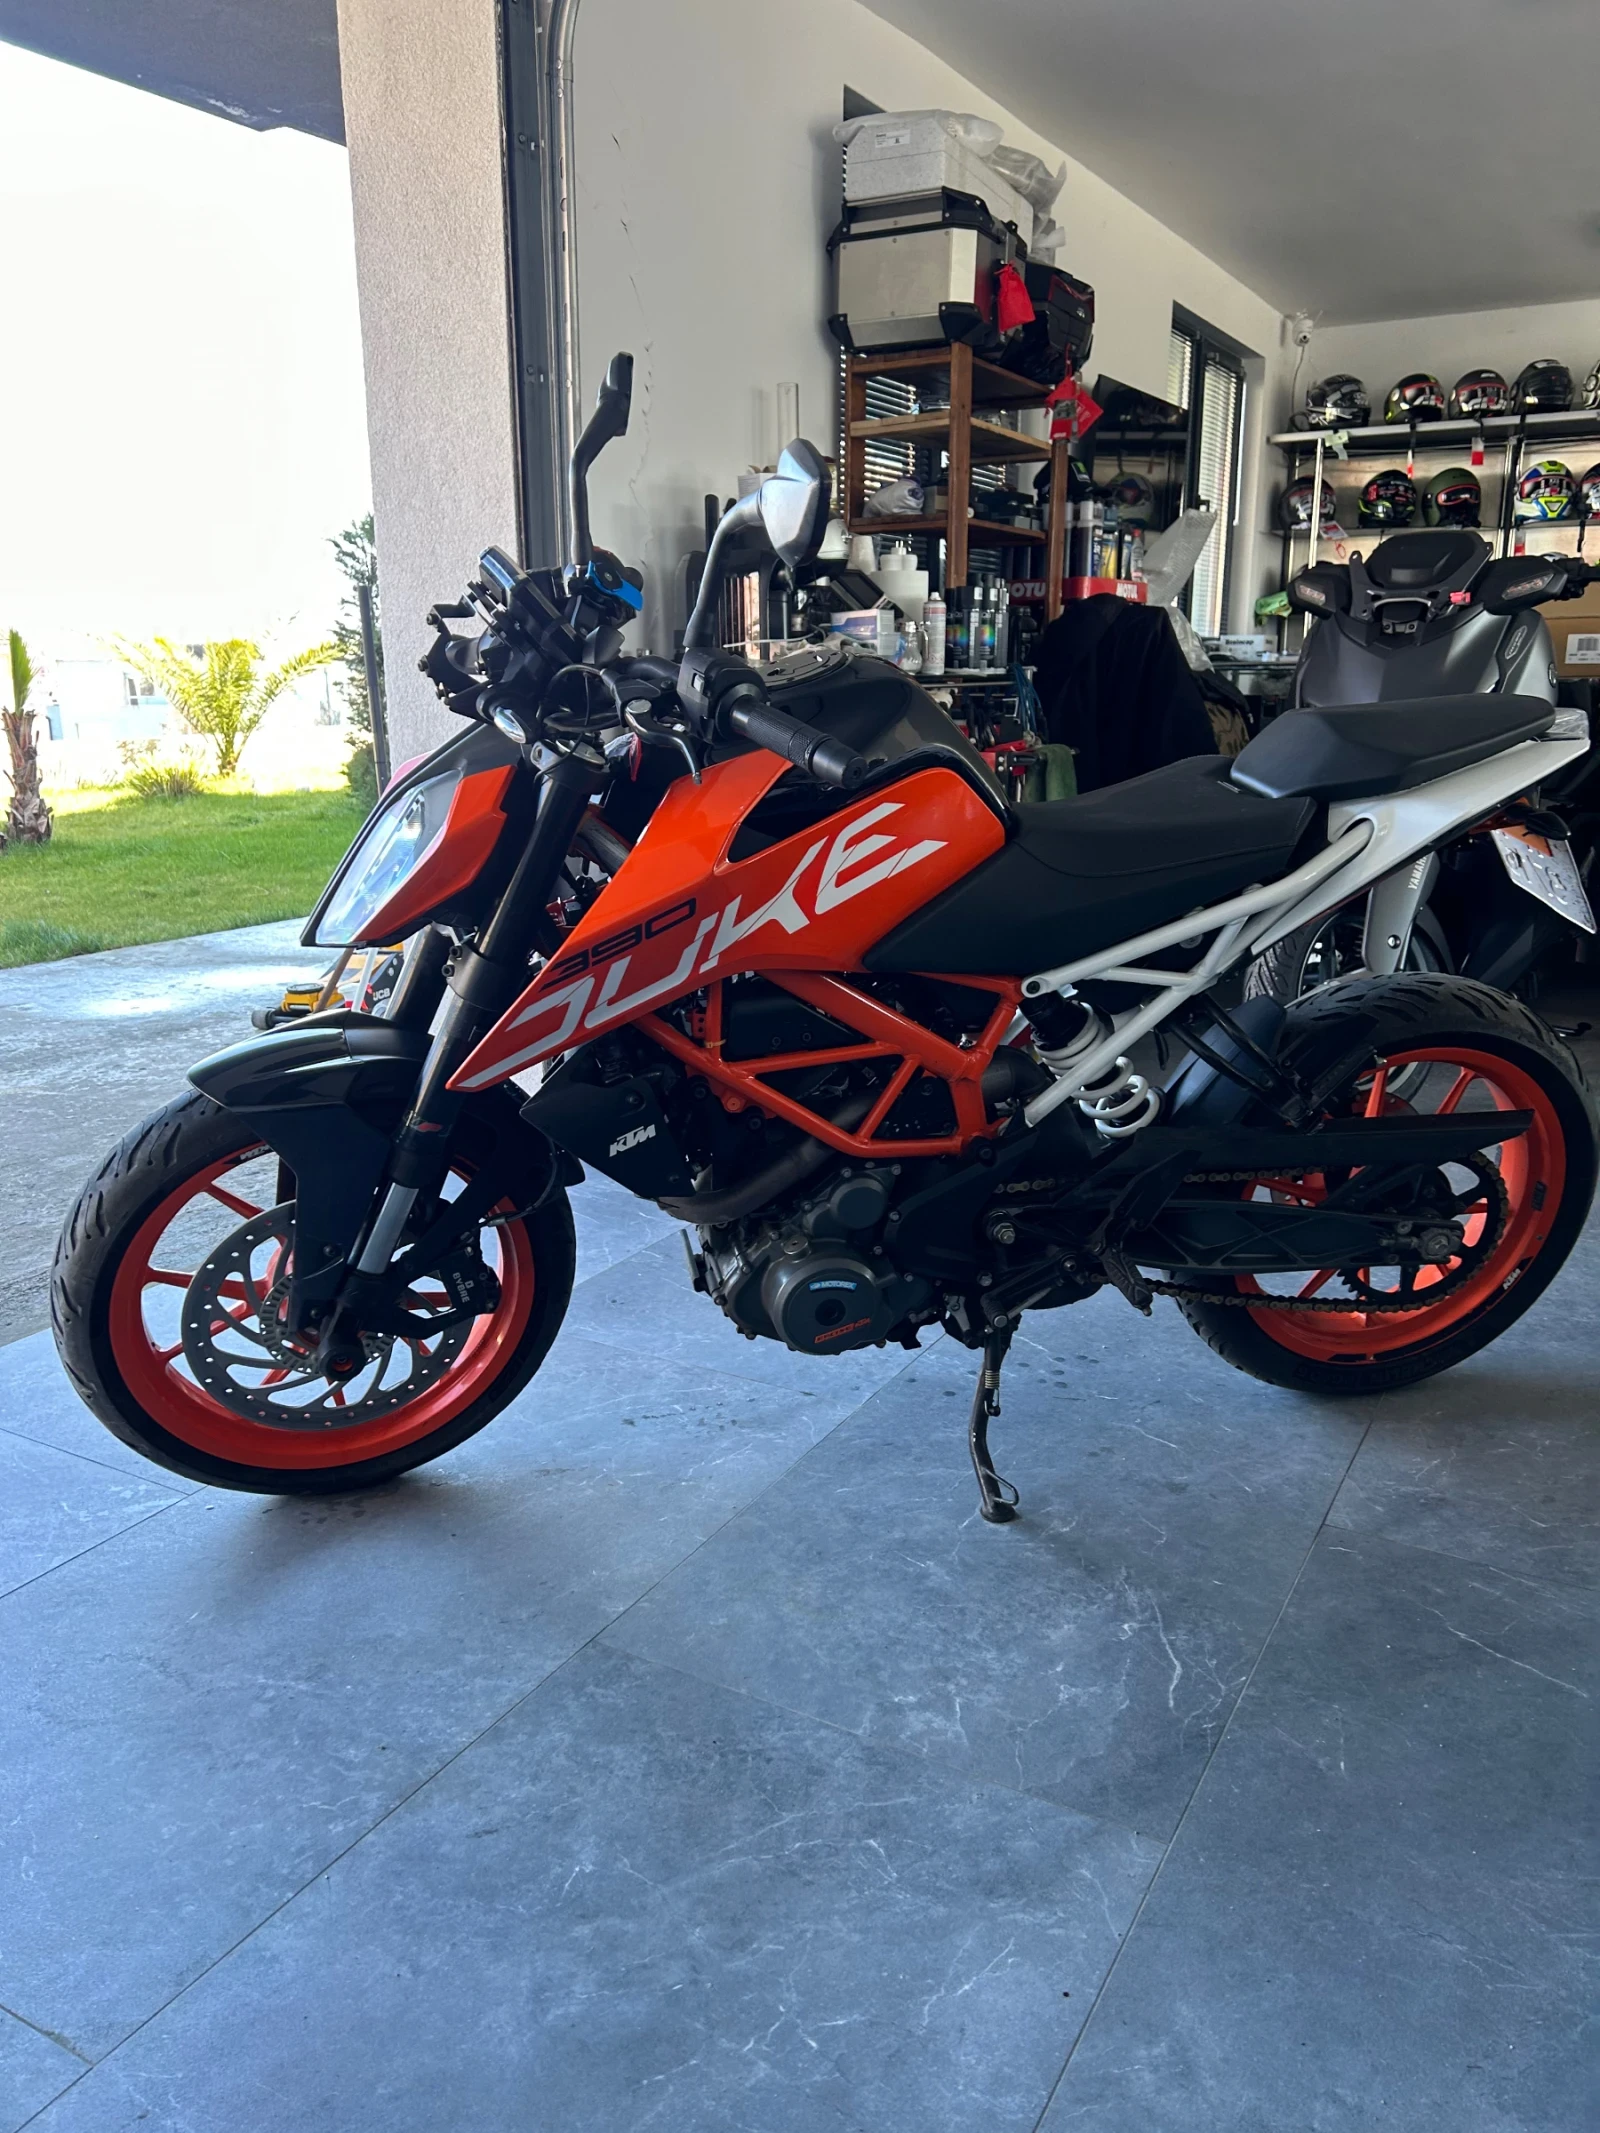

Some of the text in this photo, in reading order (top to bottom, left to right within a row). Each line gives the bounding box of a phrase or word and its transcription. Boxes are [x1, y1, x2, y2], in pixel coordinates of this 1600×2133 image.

[1007, 582, 1045, 597] OTU
[1115, 582, 1138, 599] MOTUL
[458, 802, 949, 1088] DUKE
[538, 897, 697, 993] 390
[609, 1123, 656, 1157] KTM
[453, 1272, 470, 1303] BYBRE
[821, 1280, 855, 1290] MOTOREX
